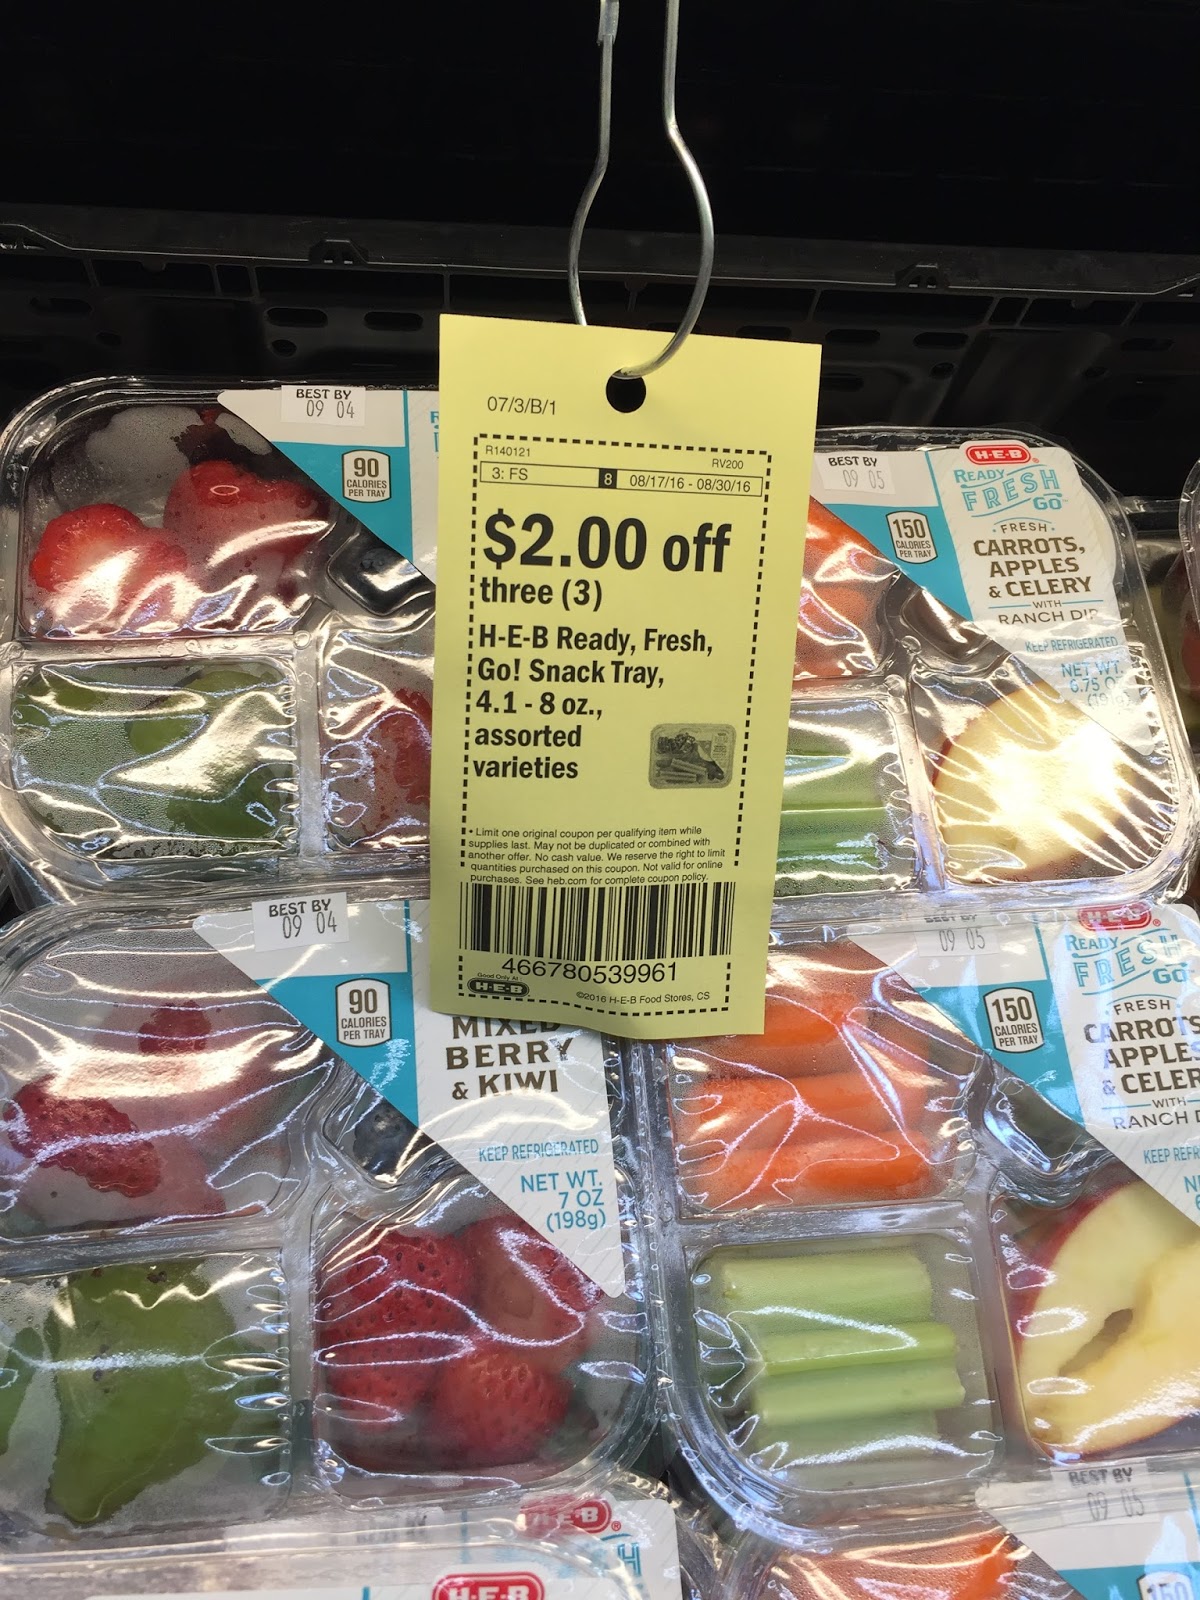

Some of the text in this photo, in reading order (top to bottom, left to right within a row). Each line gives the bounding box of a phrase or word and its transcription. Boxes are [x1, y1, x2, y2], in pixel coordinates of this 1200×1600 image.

[296, 388, 351, 400] BEST BY
[307, 400, 355, 418] 09 04
[487, 396, 557, 415] 07/3/B/1
[485, 445, 531, 457] R140121
[353, 457, 379, 478] 90
[711, 459, 744, 470] RV200
[828, 456, 878, 467] BEST BY
[491, 468, 529, 481] 3: FS
[603, 472, 613, 486] 8
[843, 471, 885, 489] 09 05
[953, 469, 1005, 483] READY
[346, 479, 387, 489] CALORIES
[348, 488, 386, 498] PER TRAY
[629, 475, 685, 490] 08/17/16
[696, 478, 751, 493] 08/30/16
[961, 468, 1060, 512] FRESH
[892, 518, 926, 539] 150
[1000, 521, 1048, 533] FRESH
[483, 508, 732, 572] $2.00 off
[895, 539, 932, 550] CALORIES
[973, 536, 1085, 556] CARROTS,
[899, 549, 932, 558] PER TRAY
[989, 557, 1080, 577] APPLES
[480, 576, 603, 611] three (3)
[989, 576, 1092, 598] & CELERY
[1032, 599, 1062, 608] WITH
[998, 610, 1065, 625] RANCH
[479, 624, 713, 657] H-E-B Ready, Fresh,
[1025, 636, 1118, 652] KEEP REFRIGERATED
[478, 657, 664, 688] Go! Snack Tray,
[1061, 660, 1124, 677] NET WT.
[1070, 678, 1101, 693] 6.75
[476, 690, 517, 714] 4.1
[539, 692, 555, 715] 8
[562, 697, 603, 720] oz.,
[474, 725, 582, 747] assorted
[473, 756, 579, 779] varieties
[476, 826, 702, 840] Limit one original coupon per qualifying item while
[468, 838, 711, 852] supplies last. May not be duplicated or combined with
[468, 848, 725, 861] another offer. No cash value. We reserve the right to limit
[470, 863, 517, 872] quantities
[519, 864, 569, 874] purchased
[586, 865, 602, 873] this
[605, 865, 640, 874] coupon.
[643, 863, 658, 872] Not
[661, 861, 681, 871] valid
[683, 861, 694, 870] for
[697, 860, 723, 869] online
[470, 872, 708, 885] purchases. See heb.com for complete coupon policy.
[269, 899, 331, 917] BEST BY
[282, 911, 337, 939] 09 04
[939, 927, 985, 951] 09 05
[1064, 935, 1118, 951] READY
[501, 957, 677, 984] 466780539961
[349, 988, 378, 1014] 90
[609, 992, 637, 1004] H-E-B
[639, 993, 661, 1004] Food
[664, 993, 694, 1003] Stores,
[697, 991, 710, 1001] CS
[991, 996, 1032, 1022] 150
[1113, 999, 1171, 1015] FRESH
[341, 1016, 387, 1029] CALORIES
[452, 1016, 562, 1039] MIXED
[994, 1023, 1038, 1037] CALORIES
[343, 1029, 385, 1040] PER TRAY
[999, 1035, 1038, 1047] PER TRAY
[446, 1037, 574, 1070] BERRY
[452, 1070, 558, 1100] & KIWI
[1102, 1068, 1200, 1096] & CELER
[1151, 1097, 1187, 1109] WITH
[1113, 1111, 1189, 1130] RANCH
[479, 1139, 598, 1162] KEEP REFRIGERATED
[1143, 1147, 1170, 1164] KEEP
[521, 1169, 603, 1193] NET WT.
[559, 1189, 604, 1208] 7 OZ
[546, 1208, 606, 1233] (198g)
[1069, 1469, 1107, 1485] BEST
[1087, 1488, 1145, 1520] 09 05
